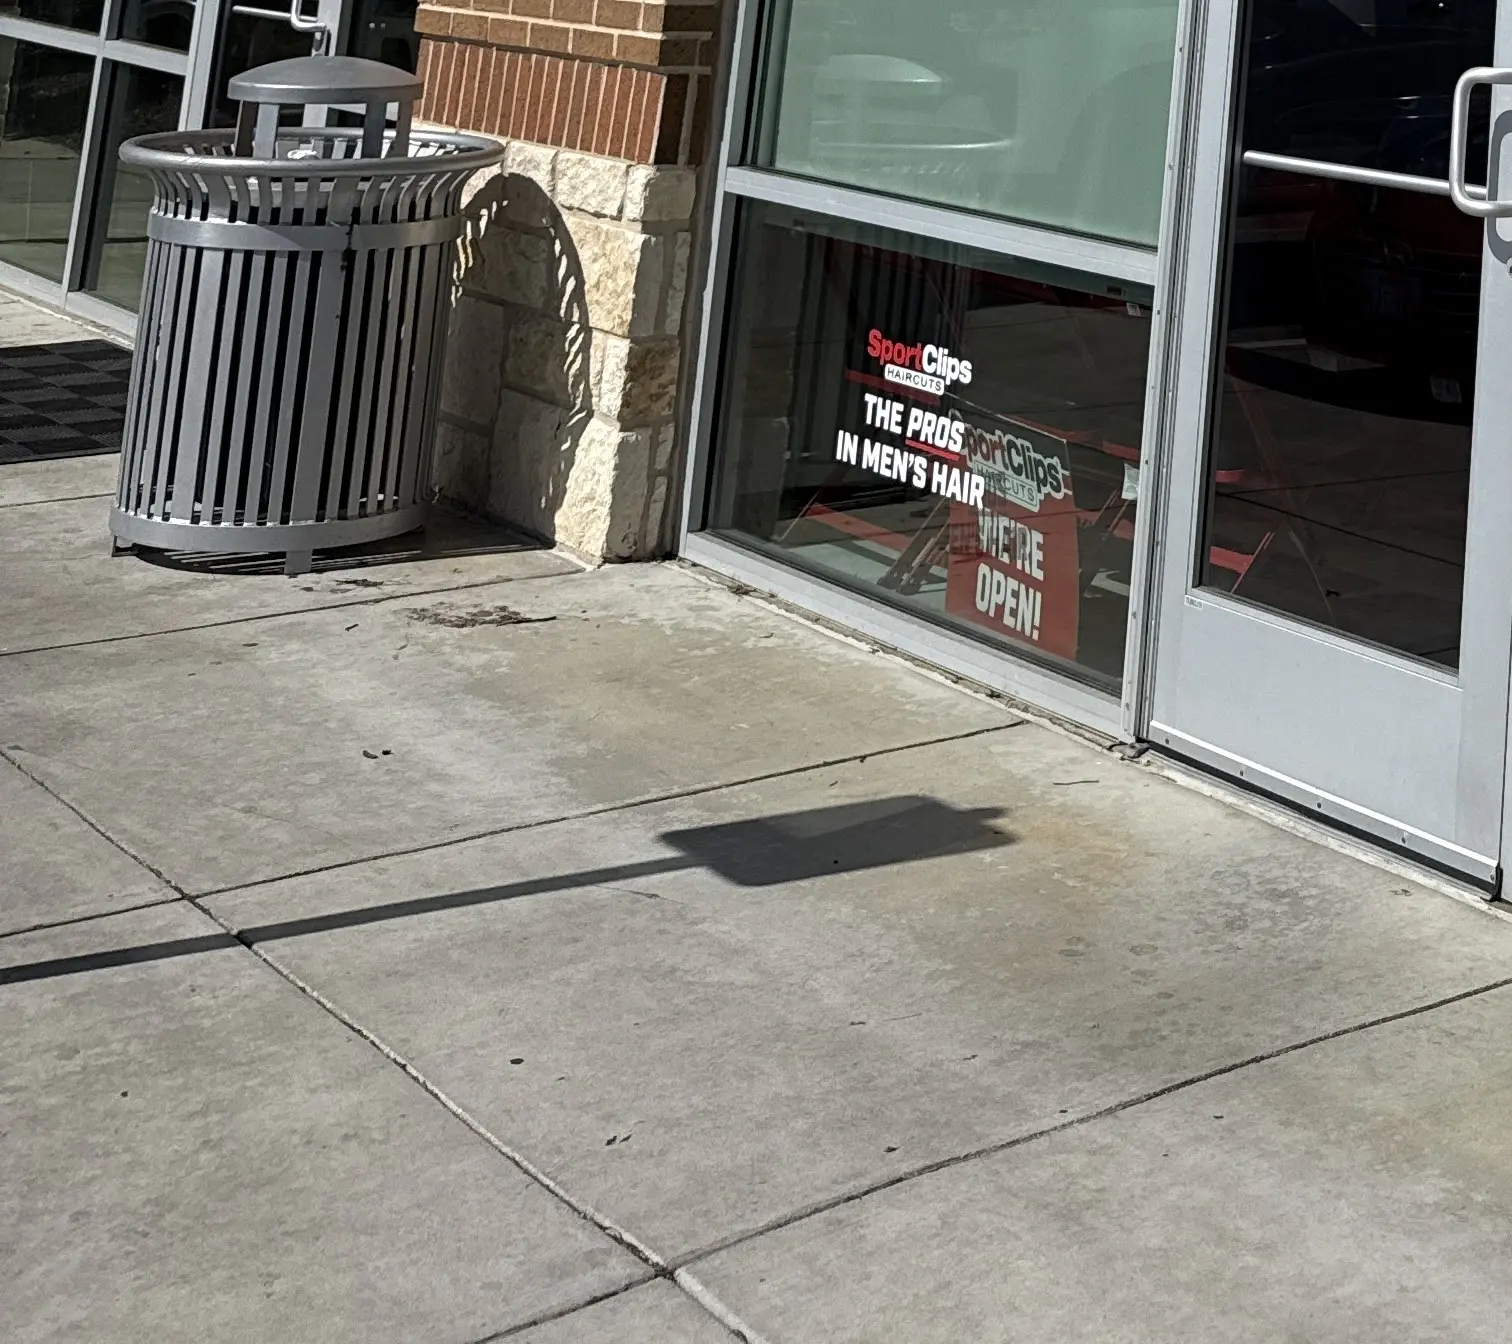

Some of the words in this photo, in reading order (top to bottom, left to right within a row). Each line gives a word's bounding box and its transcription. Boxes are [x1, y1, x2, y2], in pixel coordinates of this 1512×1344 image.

[866, 328, 972, 384] SportClips
[886, 366, 943, 393] HAIRCUTS
[864, 392, 904, 434] THE
[906, 407, 965, 454] PROS
[836, 429, 859, 465] IN
[862, 438, 927, 489] MEN'S
[931, 461, 986, 509] HAIR
[975, 562, 1042, 641] OPEN!
